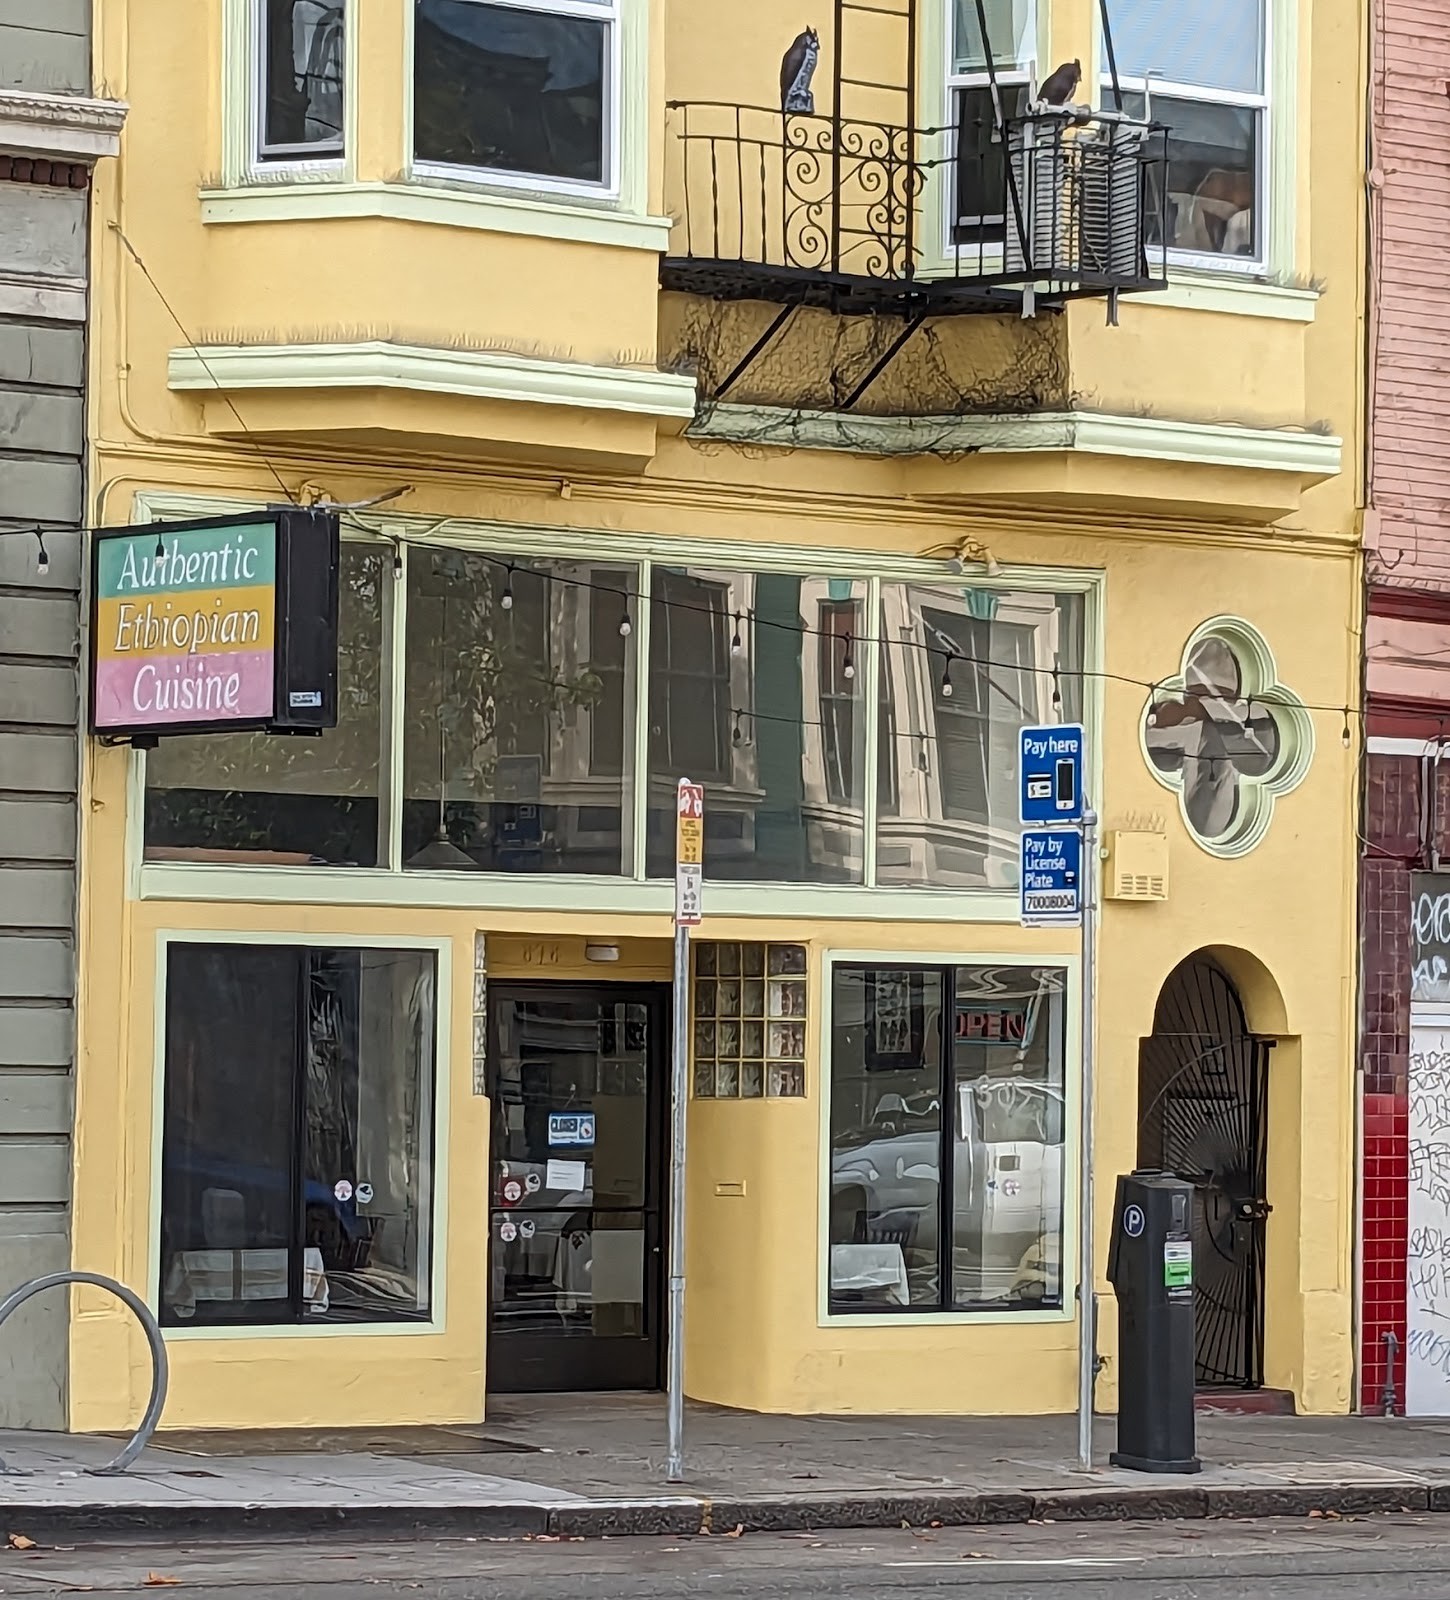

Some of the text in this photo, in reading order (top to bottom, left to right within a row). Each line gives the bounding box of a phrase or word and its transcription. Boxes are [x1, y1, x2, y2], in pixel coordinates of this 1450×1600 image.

[116, 534, 258, 590] Authentic
[114, 597, 260, 653] Ethiopian
[133, 662, 240, 712] Cuisine
[1023, 736, 1079, 759] Pay here
[1025, 836, 1063, 856] Pay by
[1025, 854, 1066, 871] License
[1025, 872, 1054, 888] Plate
